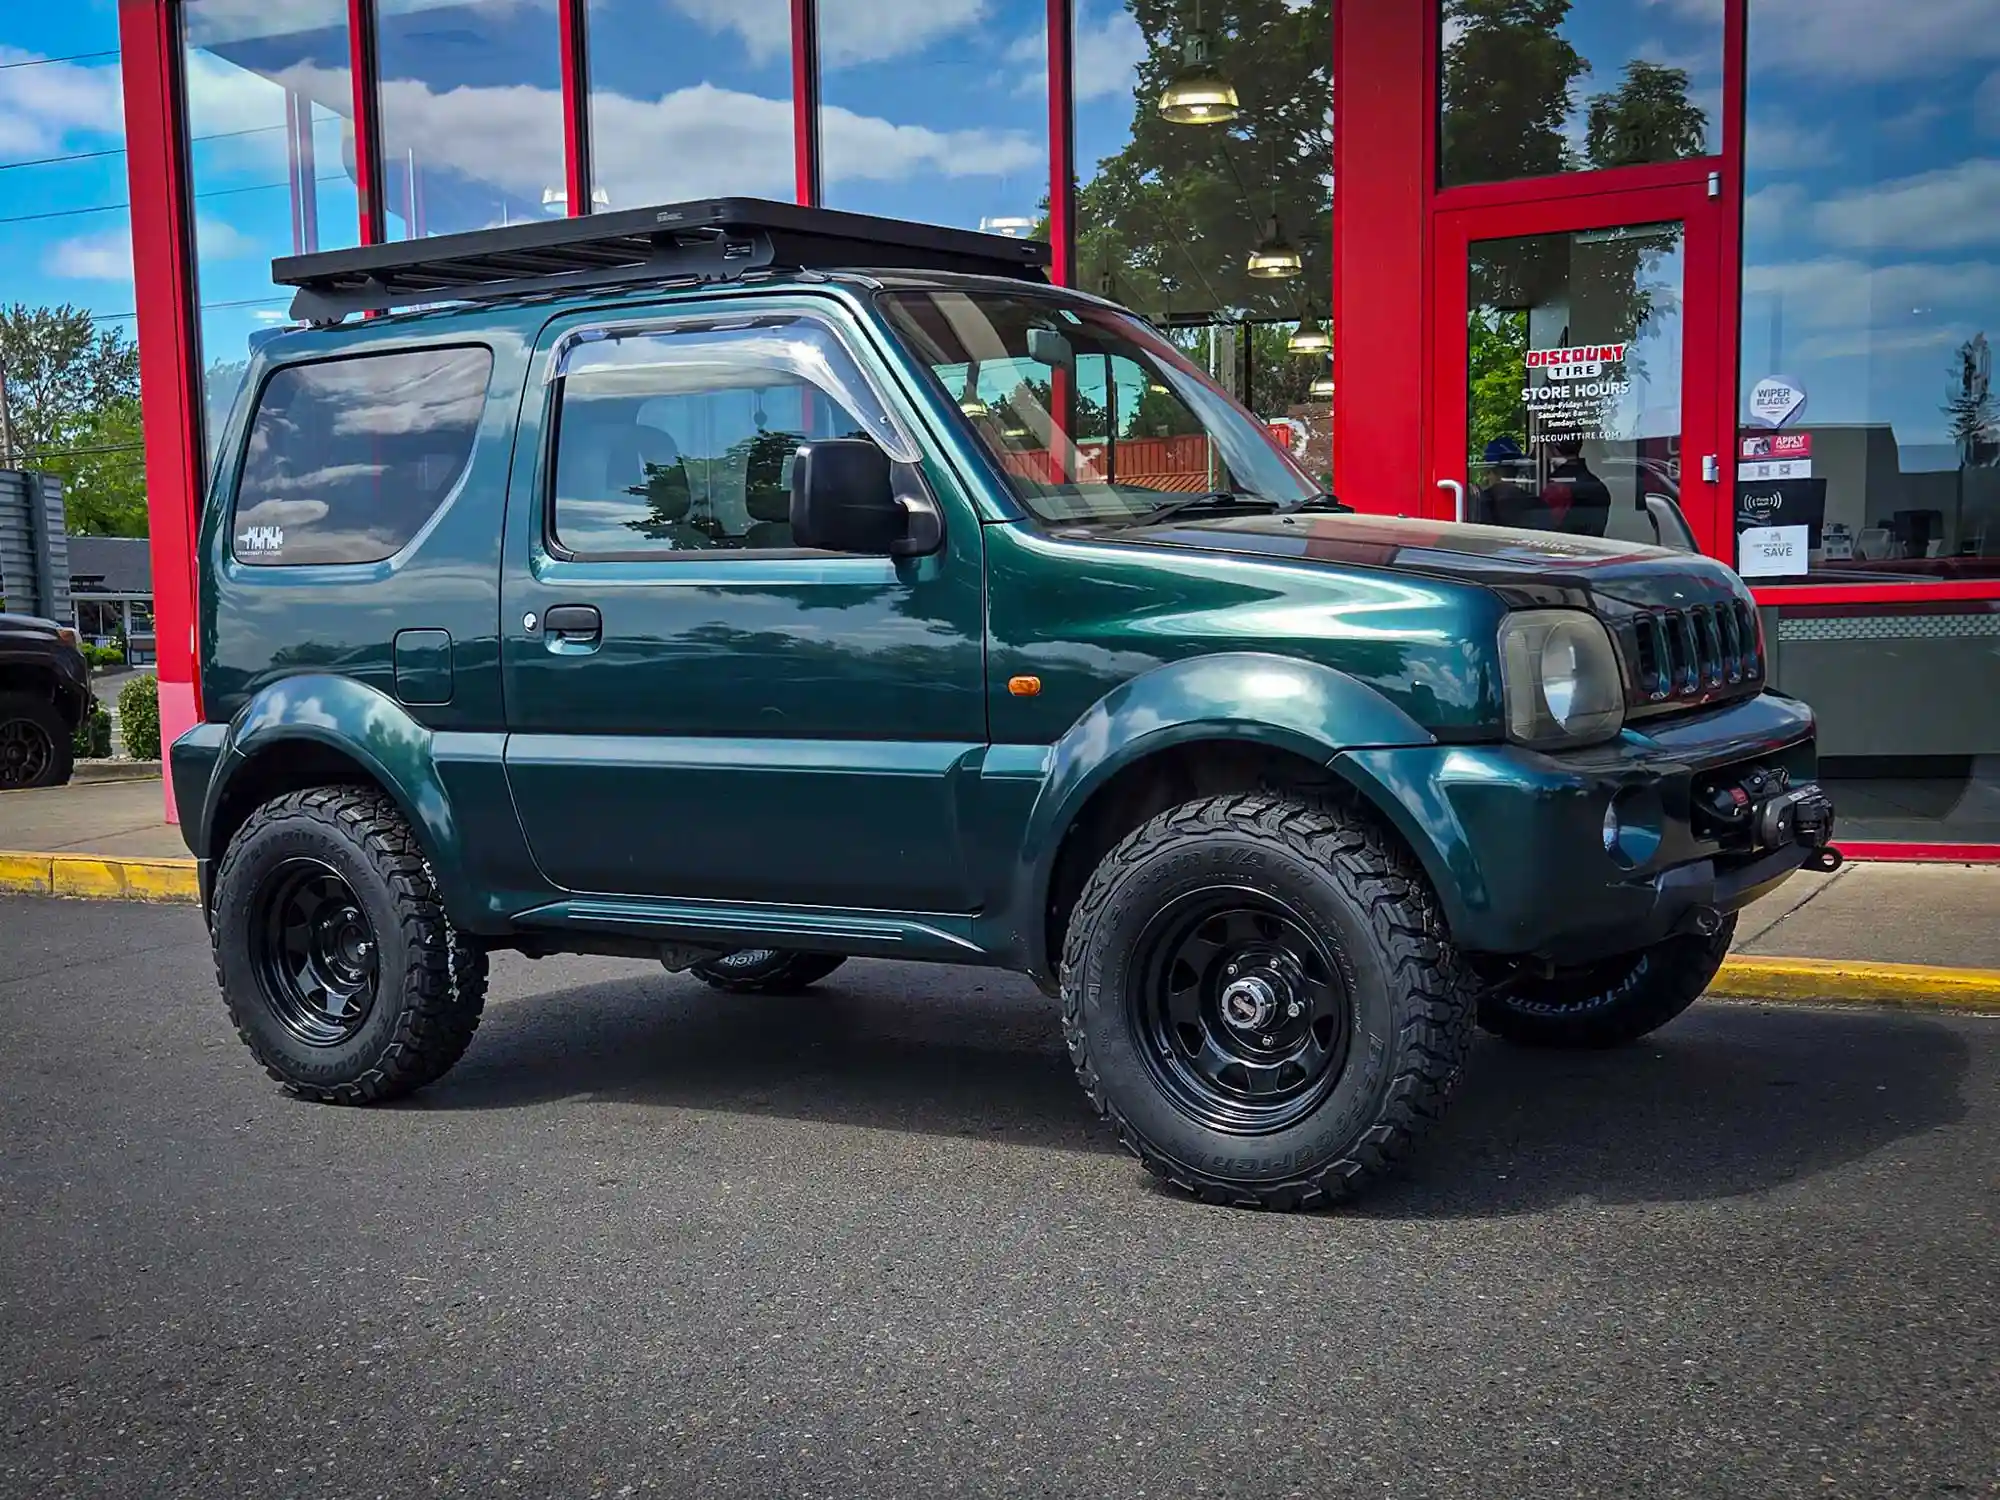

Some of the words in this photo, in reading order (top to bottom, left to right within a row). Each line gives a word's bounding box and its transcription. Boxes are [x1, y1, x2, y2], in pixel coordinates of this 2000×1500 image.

[1527, 345, 1625, 367] DISCOUNT
[1554, 365, 1595, 377] TIRE
[1521, 387, 1571, 401] STORE
[1575, 382, 1630, 398] HOURS
[1757, 388, 1791, 397] WIPER
[1757, 397, 1791, 406] BLADES
[1537, 410, 1571, 419] Saturday:
[1548, 420, 1576, 428] Sunday:
[1531, 431, 1619, 443] DISCOUNTTIRE.COM
[1776, 435, 1805, 445] APPLY
[1763, 547, 1793, 557] SAVE
